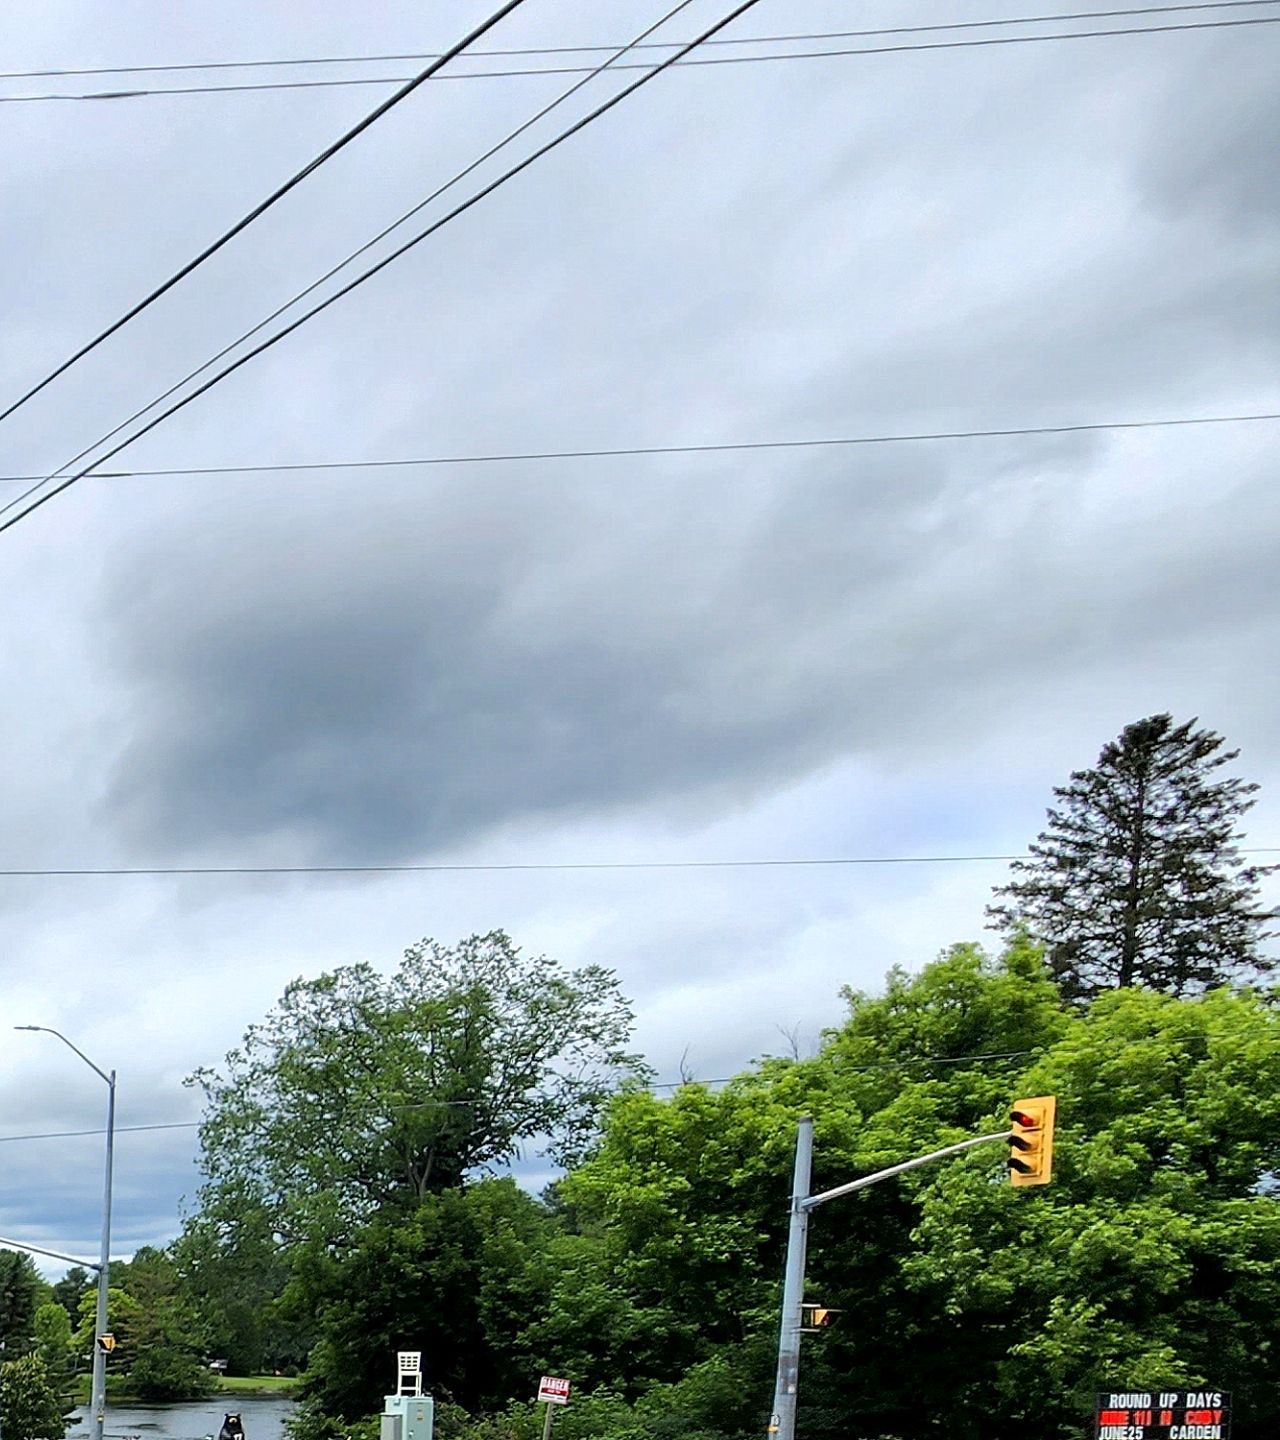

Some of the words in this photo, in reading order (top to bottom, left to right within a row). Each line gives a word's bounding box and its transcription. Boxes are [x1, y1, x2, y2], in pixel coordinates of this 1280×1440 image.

[1109, 1393, 1152, 1409] ROUND
[1159, 1393, 1178, 1408] UP
[1186, 1392, 1222, 1408] DAYS
[1170, 1425, 1221, 1440] CARDEN
